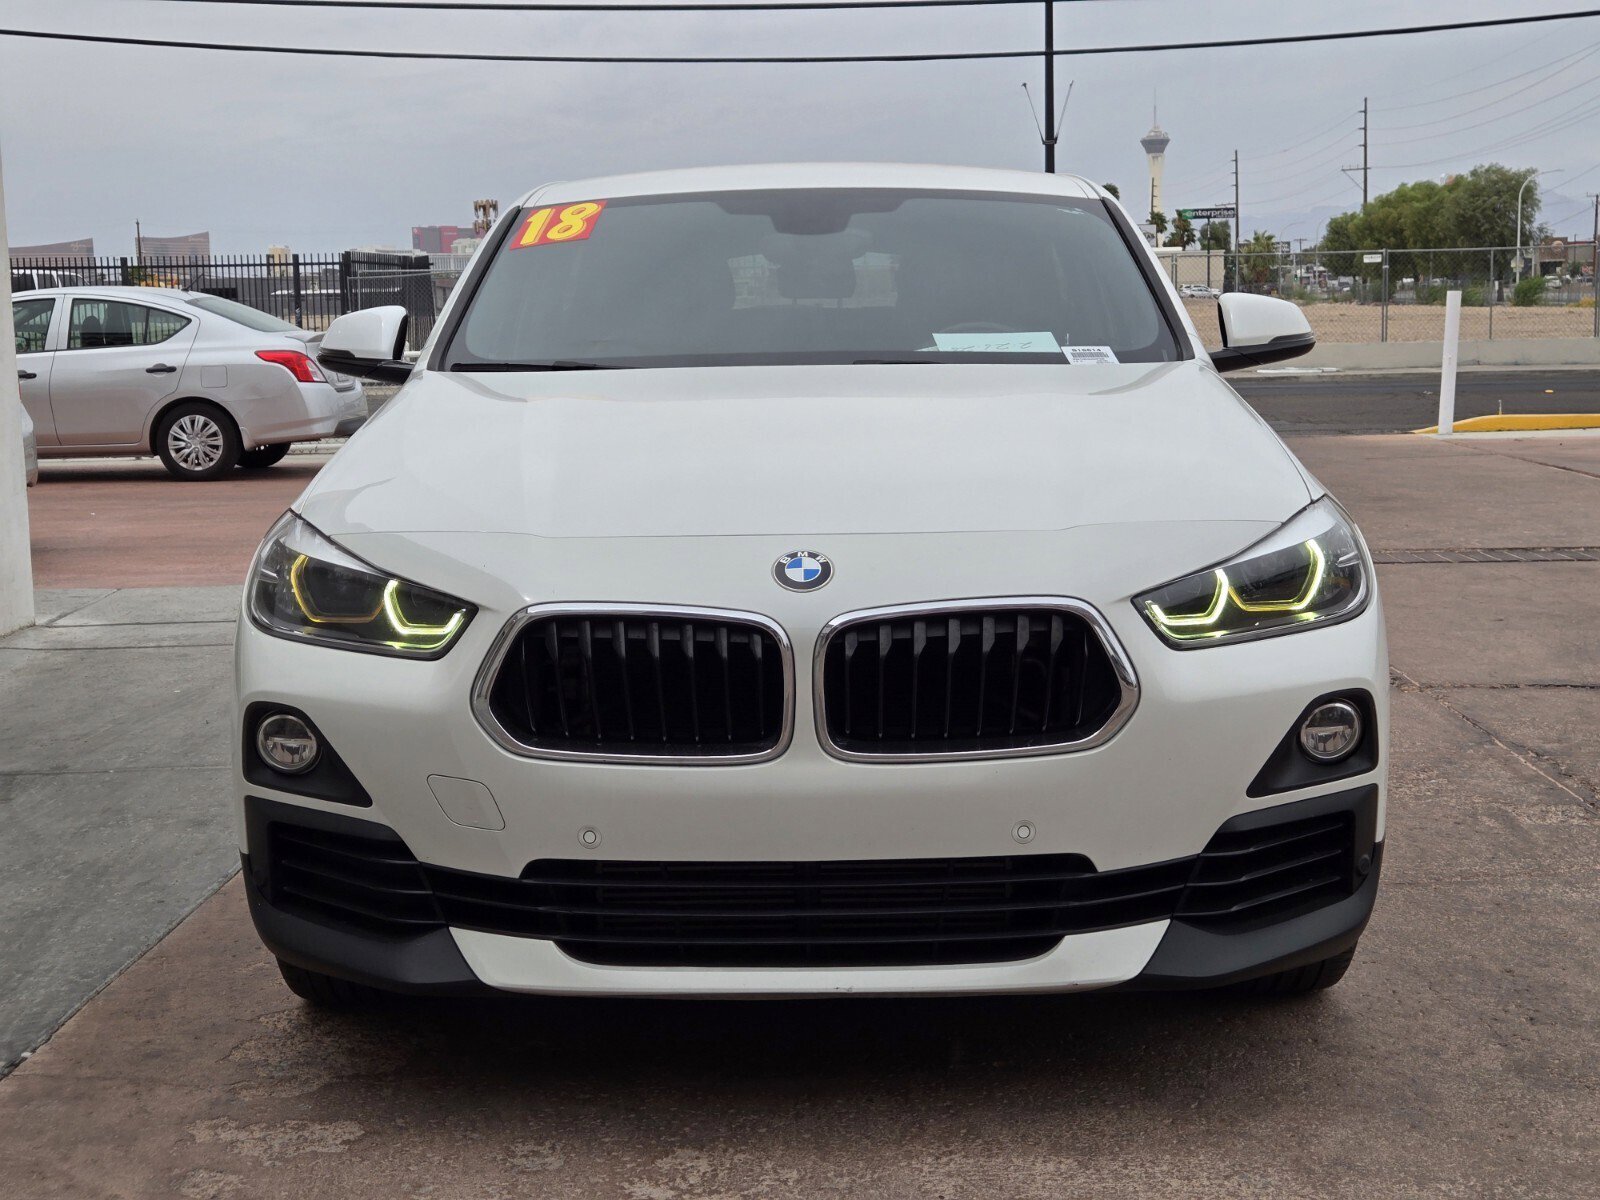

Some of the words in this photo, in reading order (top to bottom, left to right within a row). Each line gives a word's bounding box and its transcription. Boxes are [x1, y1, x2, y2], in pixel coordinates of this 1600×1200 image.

[1184, 209, 1234, 217] enterprise
[520, 202, 602, 247] 18
[779, 551, 828, 564] BMW
